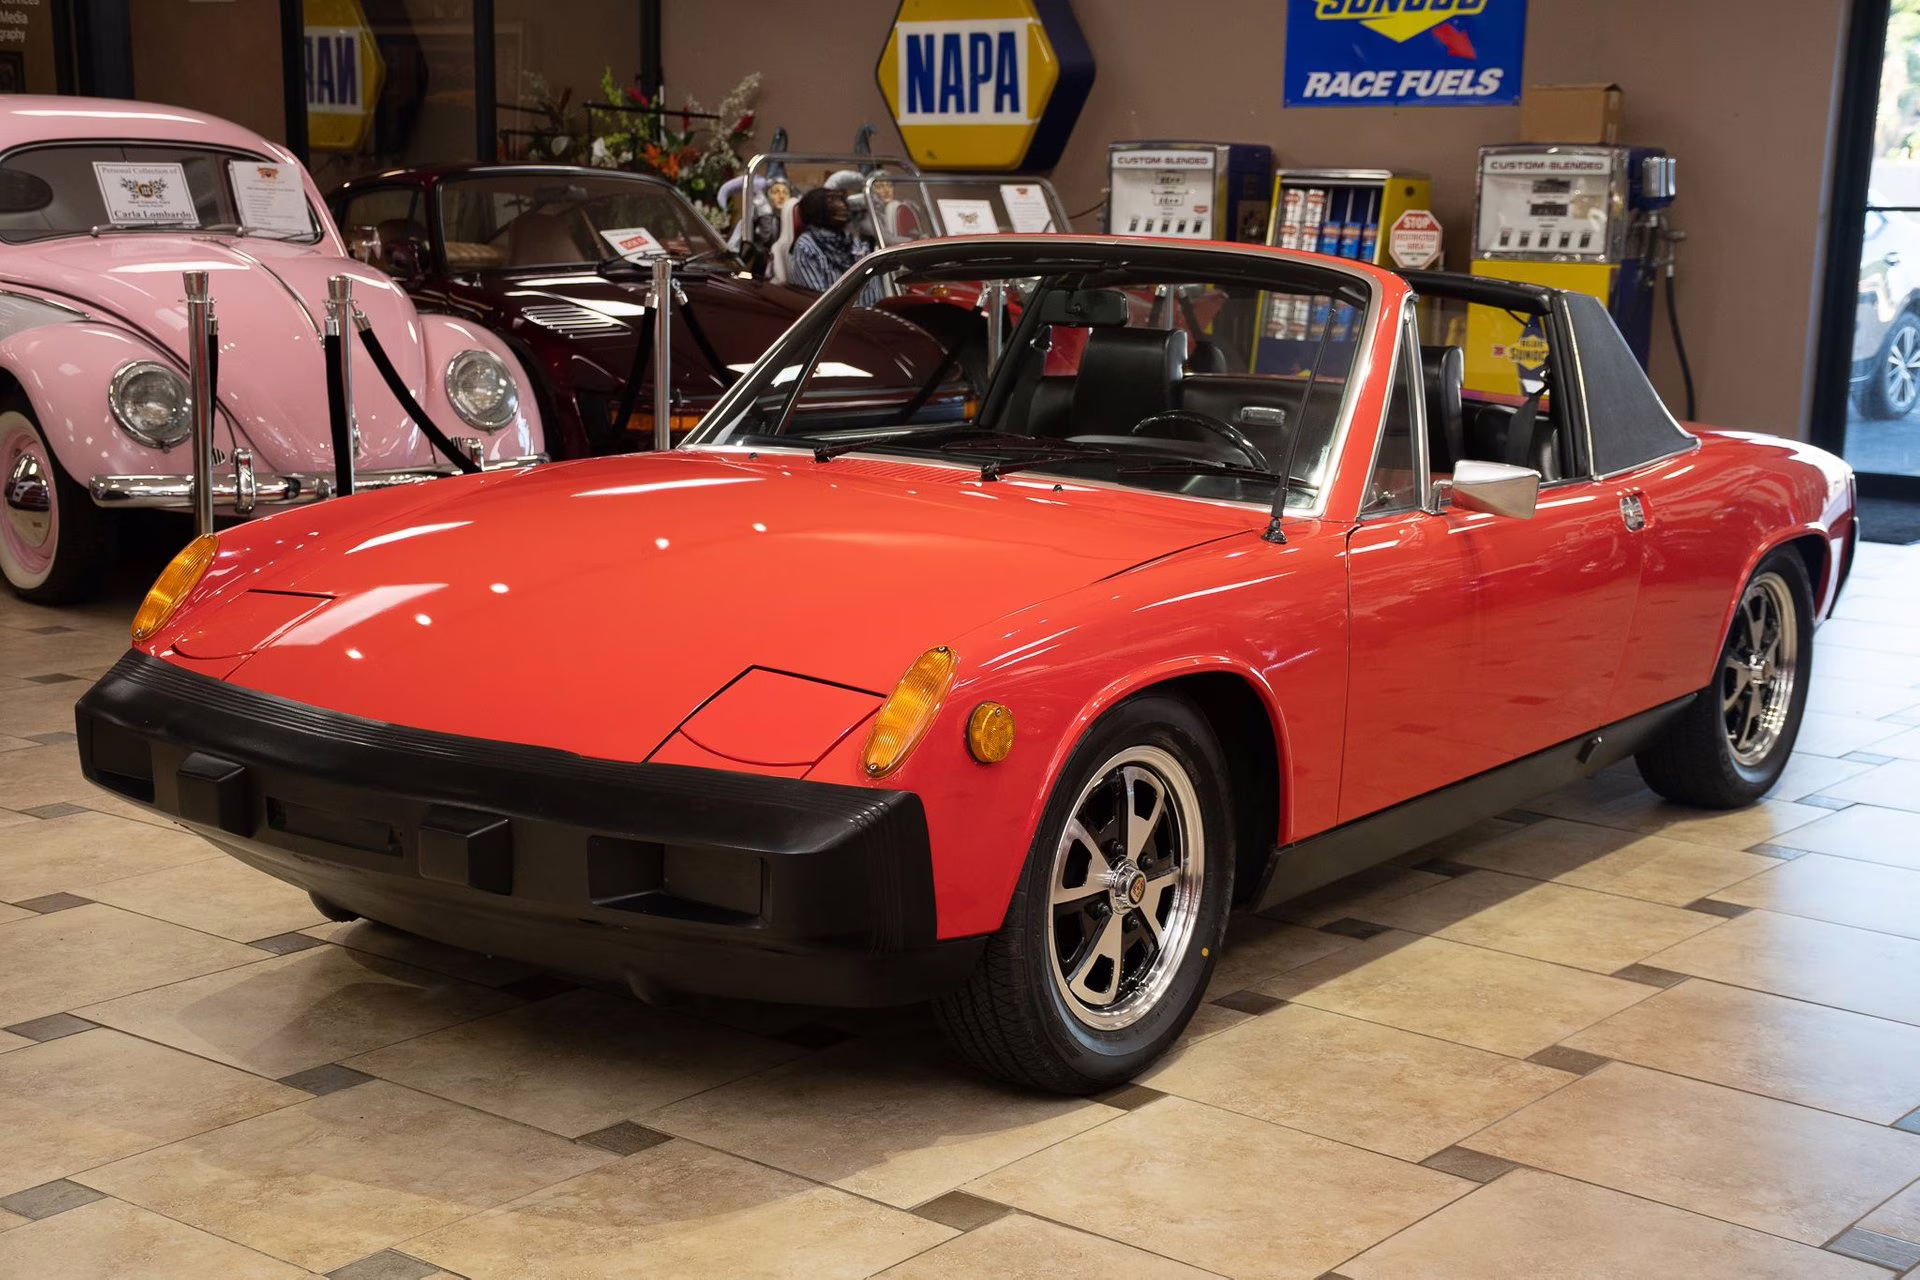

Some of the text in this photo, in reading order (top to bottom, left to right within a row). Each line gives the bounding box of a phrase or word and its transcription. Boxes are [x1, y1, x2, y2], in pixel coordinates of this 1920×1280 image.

[906, 32, 1020, 114] NAPA
[1303, 67, 1504, 97] RACE FUELS
[1403, 216, 1430, 229] STOP
